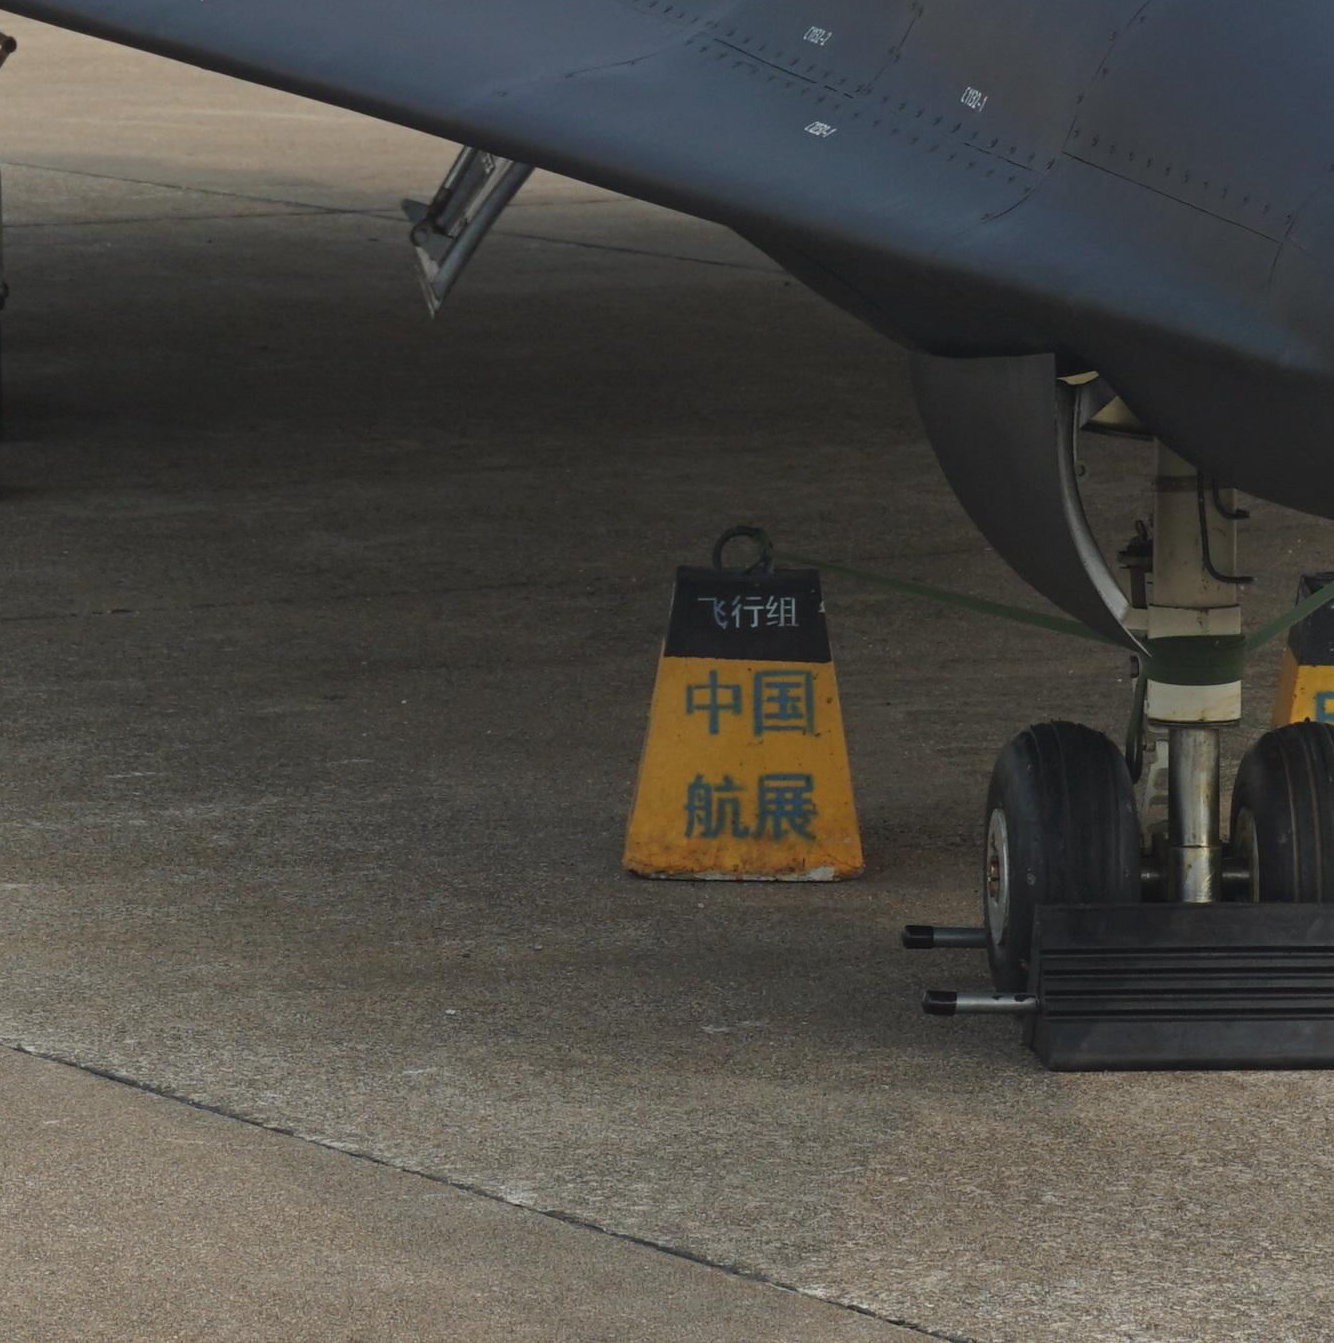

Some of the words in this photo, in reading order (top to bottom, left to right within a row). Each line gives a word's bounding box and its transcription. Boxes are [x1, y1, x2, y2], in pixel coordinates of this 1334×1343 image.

[697, 595, 799, 629] 飞行组
[685, 669, 815, 737] 中国
[683, 773, 817, 842] 航展
